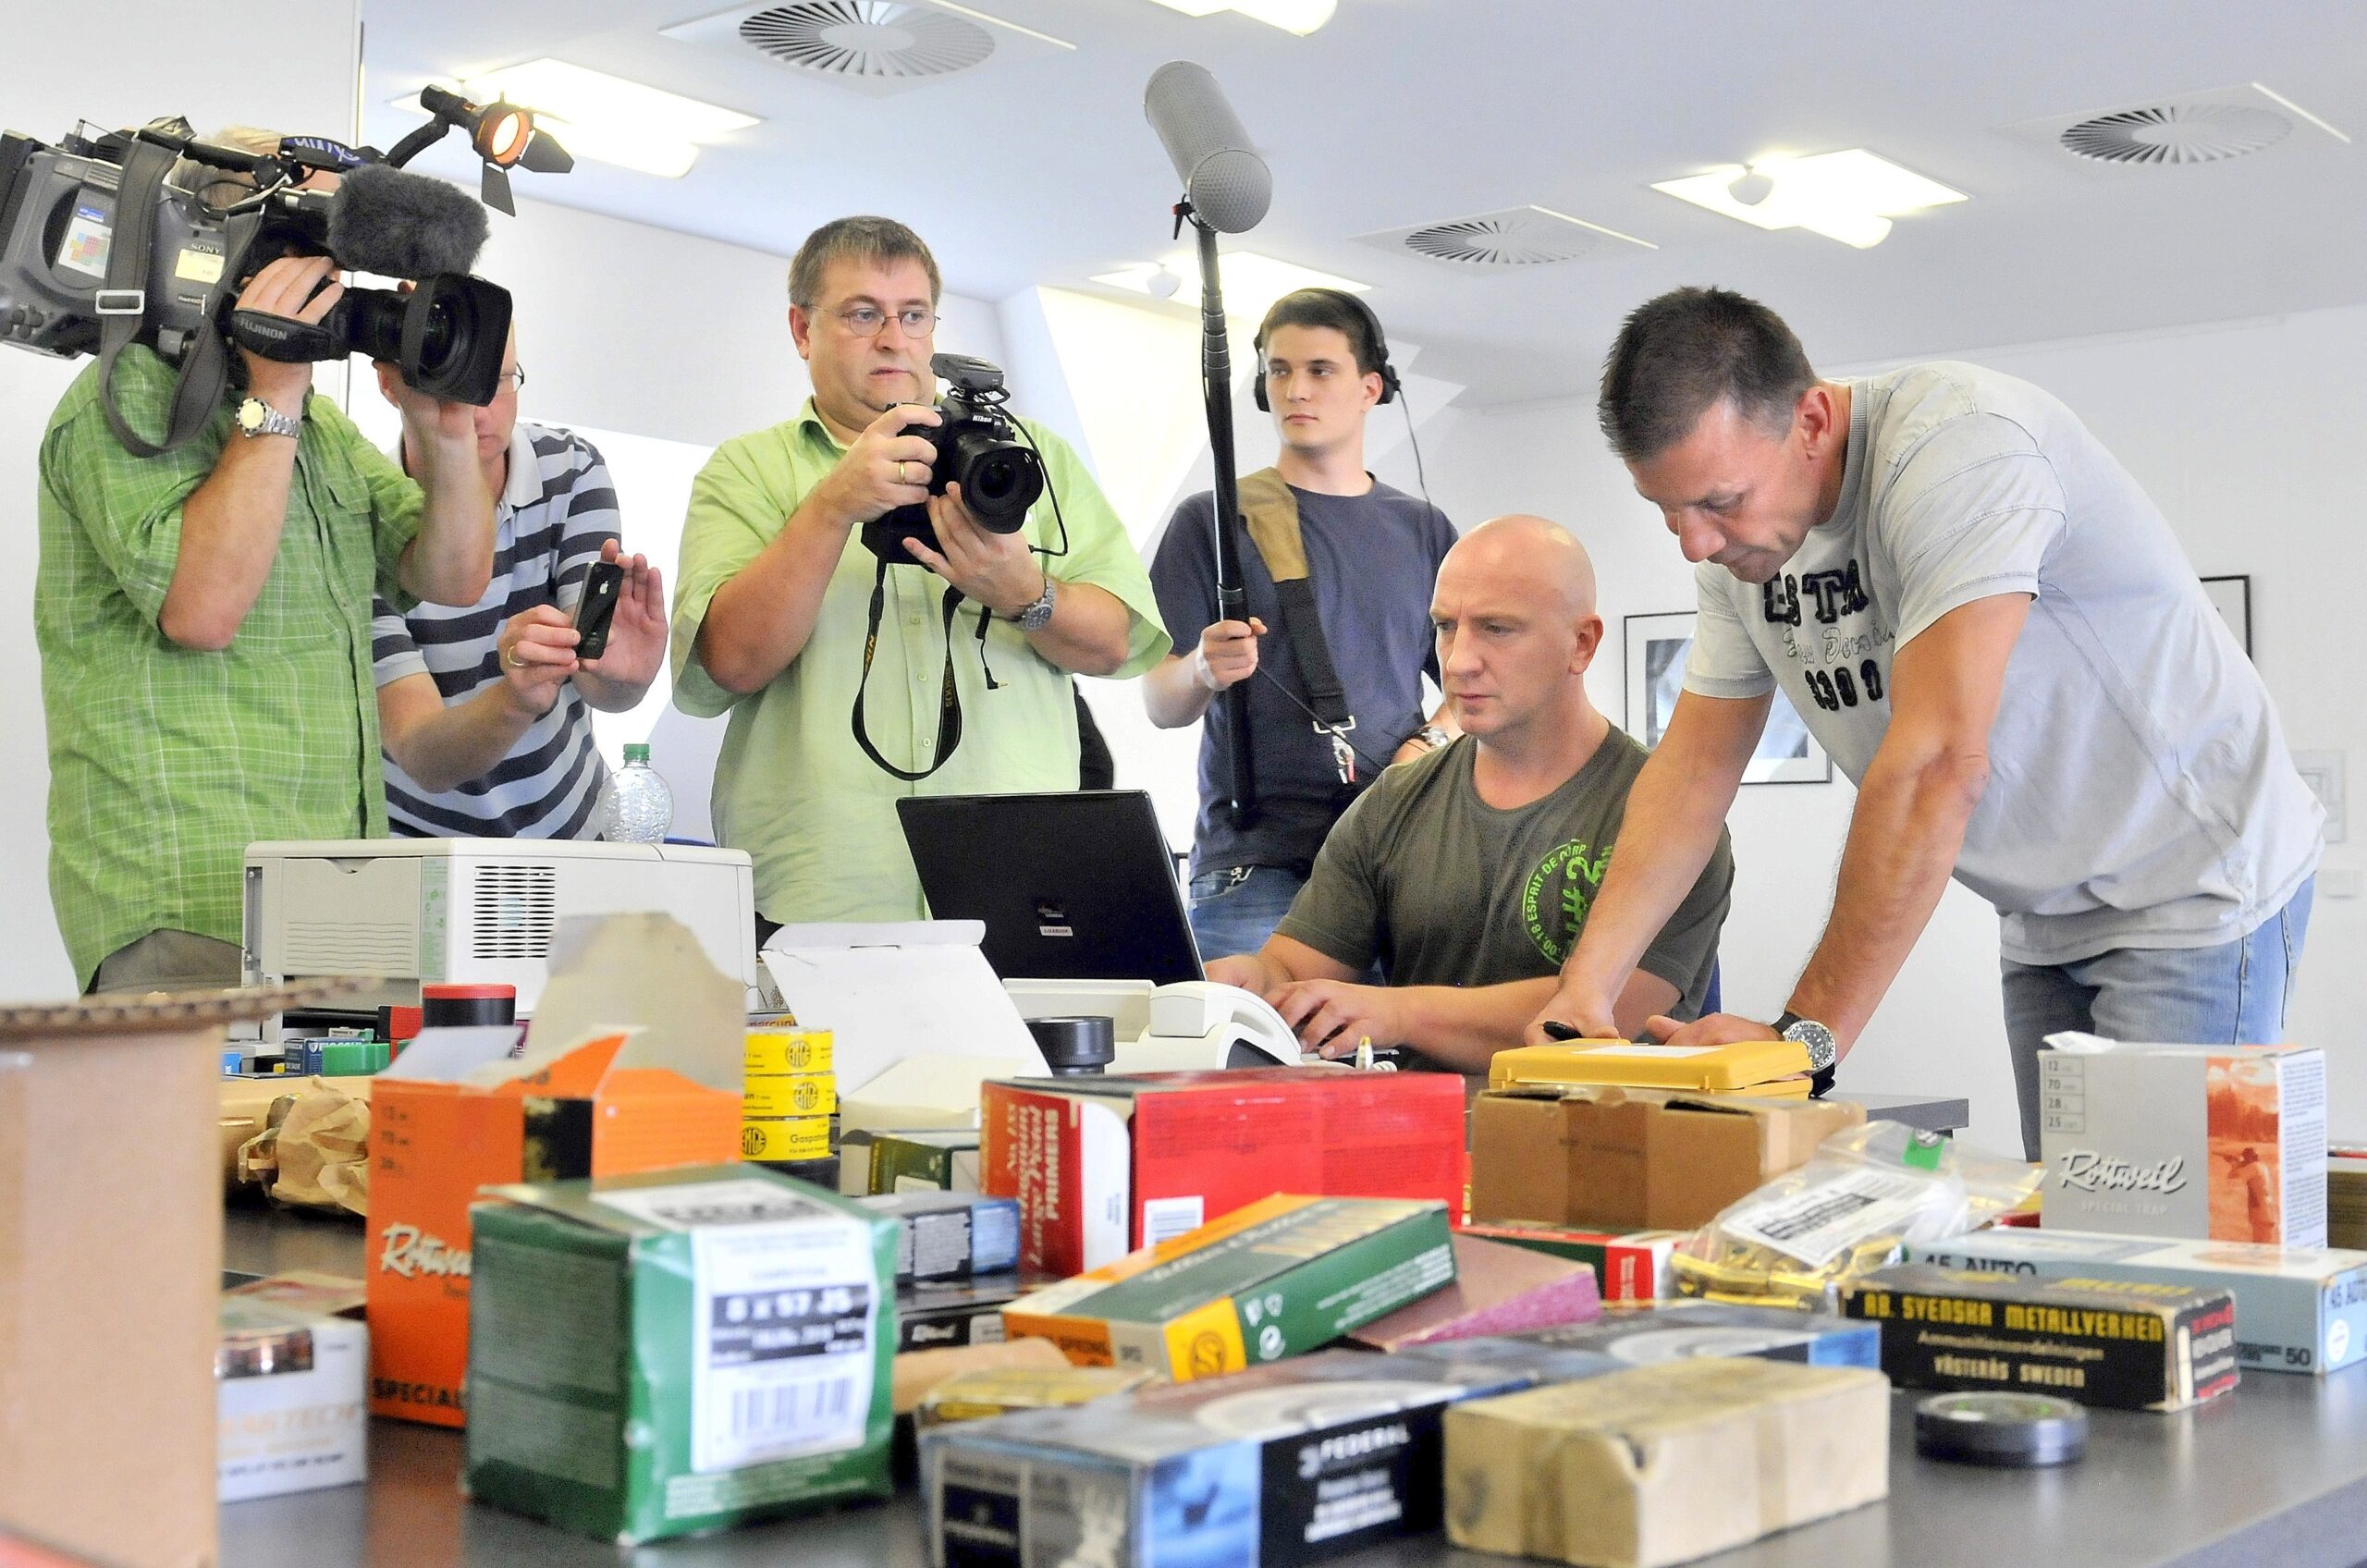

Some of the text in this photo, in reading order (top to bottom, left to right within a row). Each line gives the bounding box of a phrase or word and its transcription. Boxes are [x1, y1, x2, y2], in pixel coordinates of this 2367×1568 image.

[190, 243, 222, 255] SONY
[239, 317, 288, 341] FUJINON
[972, 414, 993, 423] Nikon
[1527, 875, 1544, 922] ESPRIT
[1541, 857, 1559, 875] DE
[2047, 1060, 2059, 1072] 12
[2047, 1079, 2061, 1090] 70
[1044, 1108, 1060, 1221] PRIMERS
[2058, 1147, 2188, 1194] Rottweil
[2081, 1201, 2168, 1216] SPECIAL TRAP
[1901, 1294, 1993, 1328] SVENSKA
[2005, 1305, 2165, 1342] METALLVERKEN
[2285, 1346, 2312, 1366] 50
[2019, 1363, 2086, 1389] SWEDEN
[1320, 1423, 1411, 1460] FEDERAL
